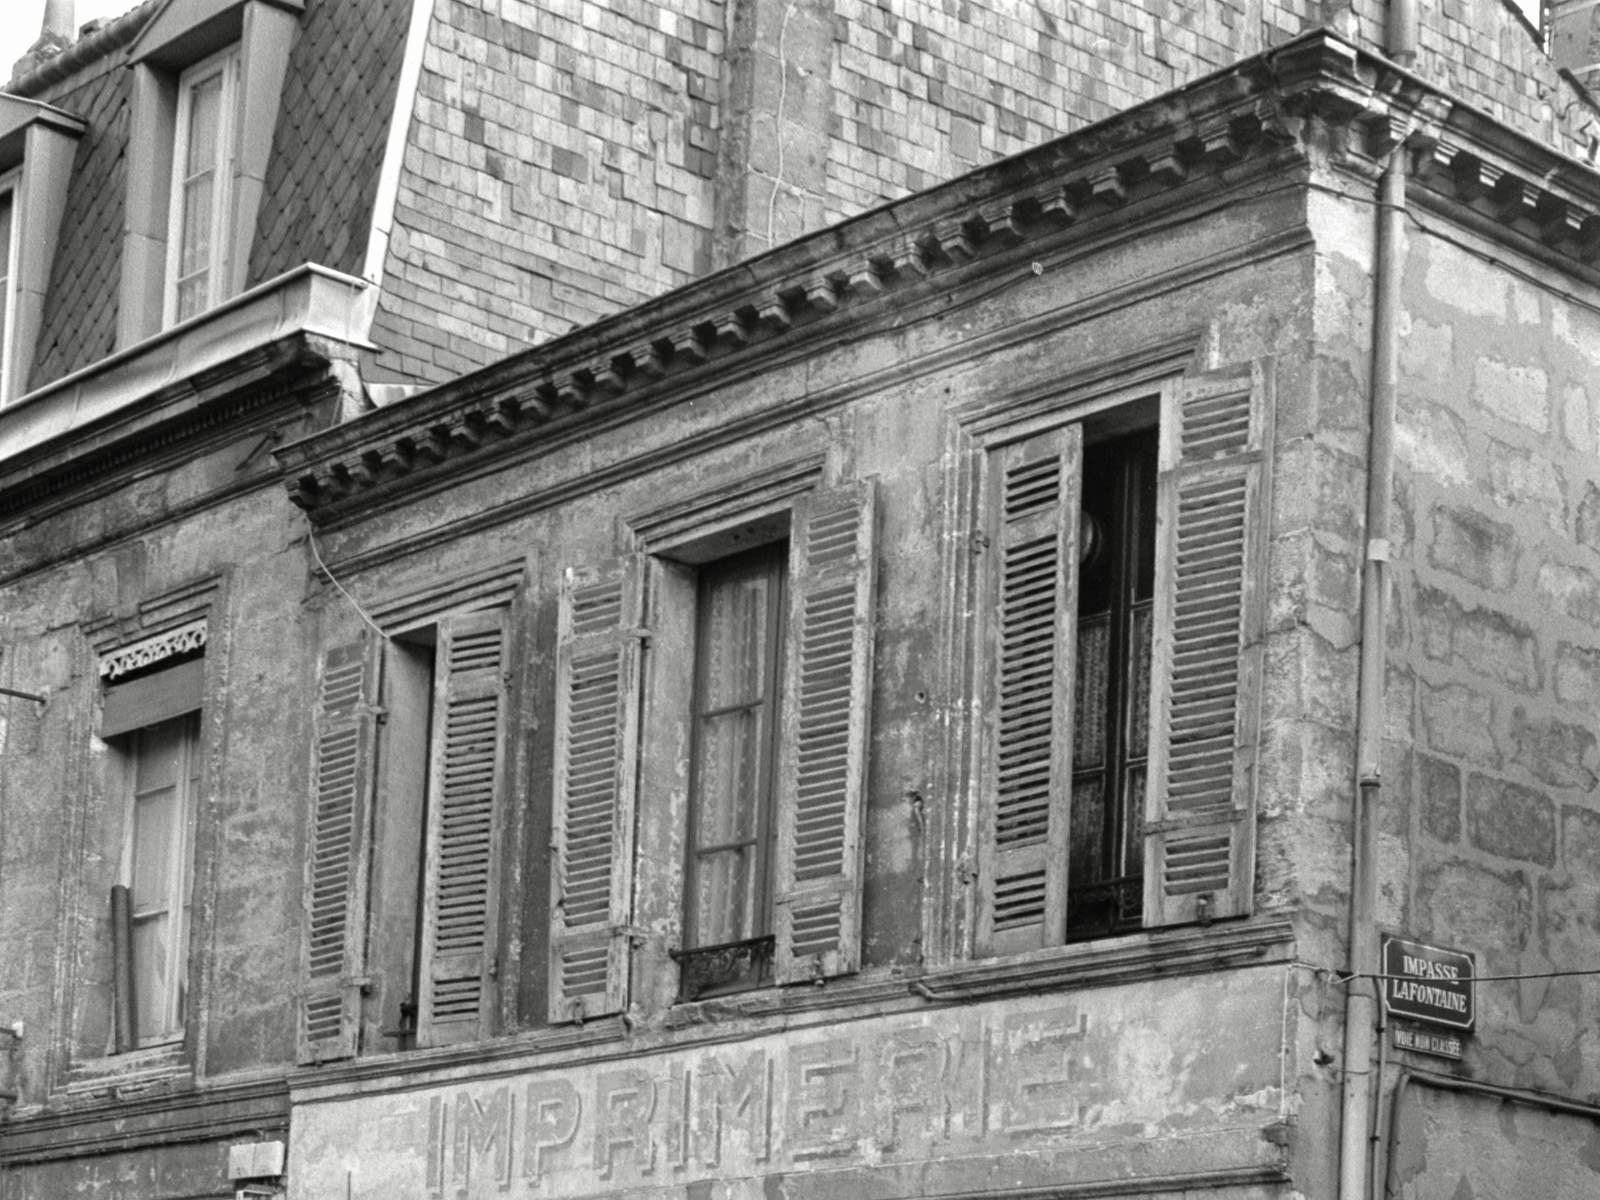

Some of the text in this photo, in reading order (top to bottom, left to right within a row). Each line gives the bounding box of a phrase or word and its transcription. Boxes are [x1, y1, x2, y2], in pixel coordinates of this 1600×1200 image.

[1403, 955, 1459, 985] IMPASSE
[1392, 978, 1467, 1013] LAFONTAINE
[425, 1002, 1088, 1200] IMPRIMERIE
